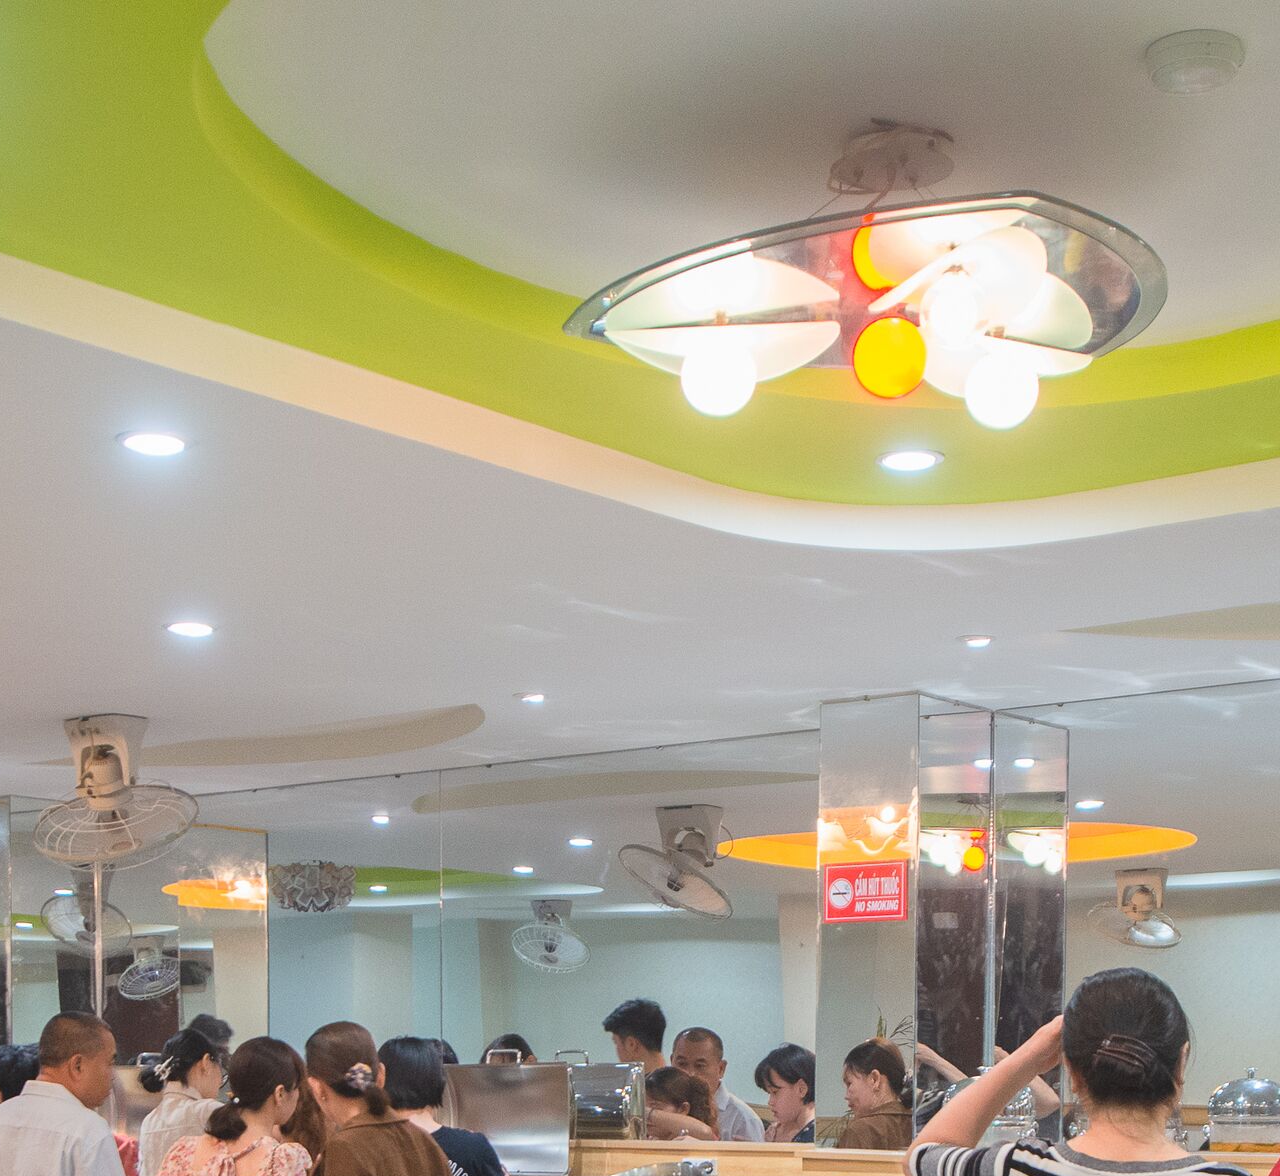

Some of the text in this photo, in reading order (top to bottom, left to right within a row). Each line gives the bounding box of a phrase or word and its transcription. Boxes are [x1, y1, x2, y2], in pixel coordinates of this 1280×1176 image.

[855, 869, 900, 897] CẤM HÚT THUỐC
[855, 899, 899, 913] NO SMOKING
